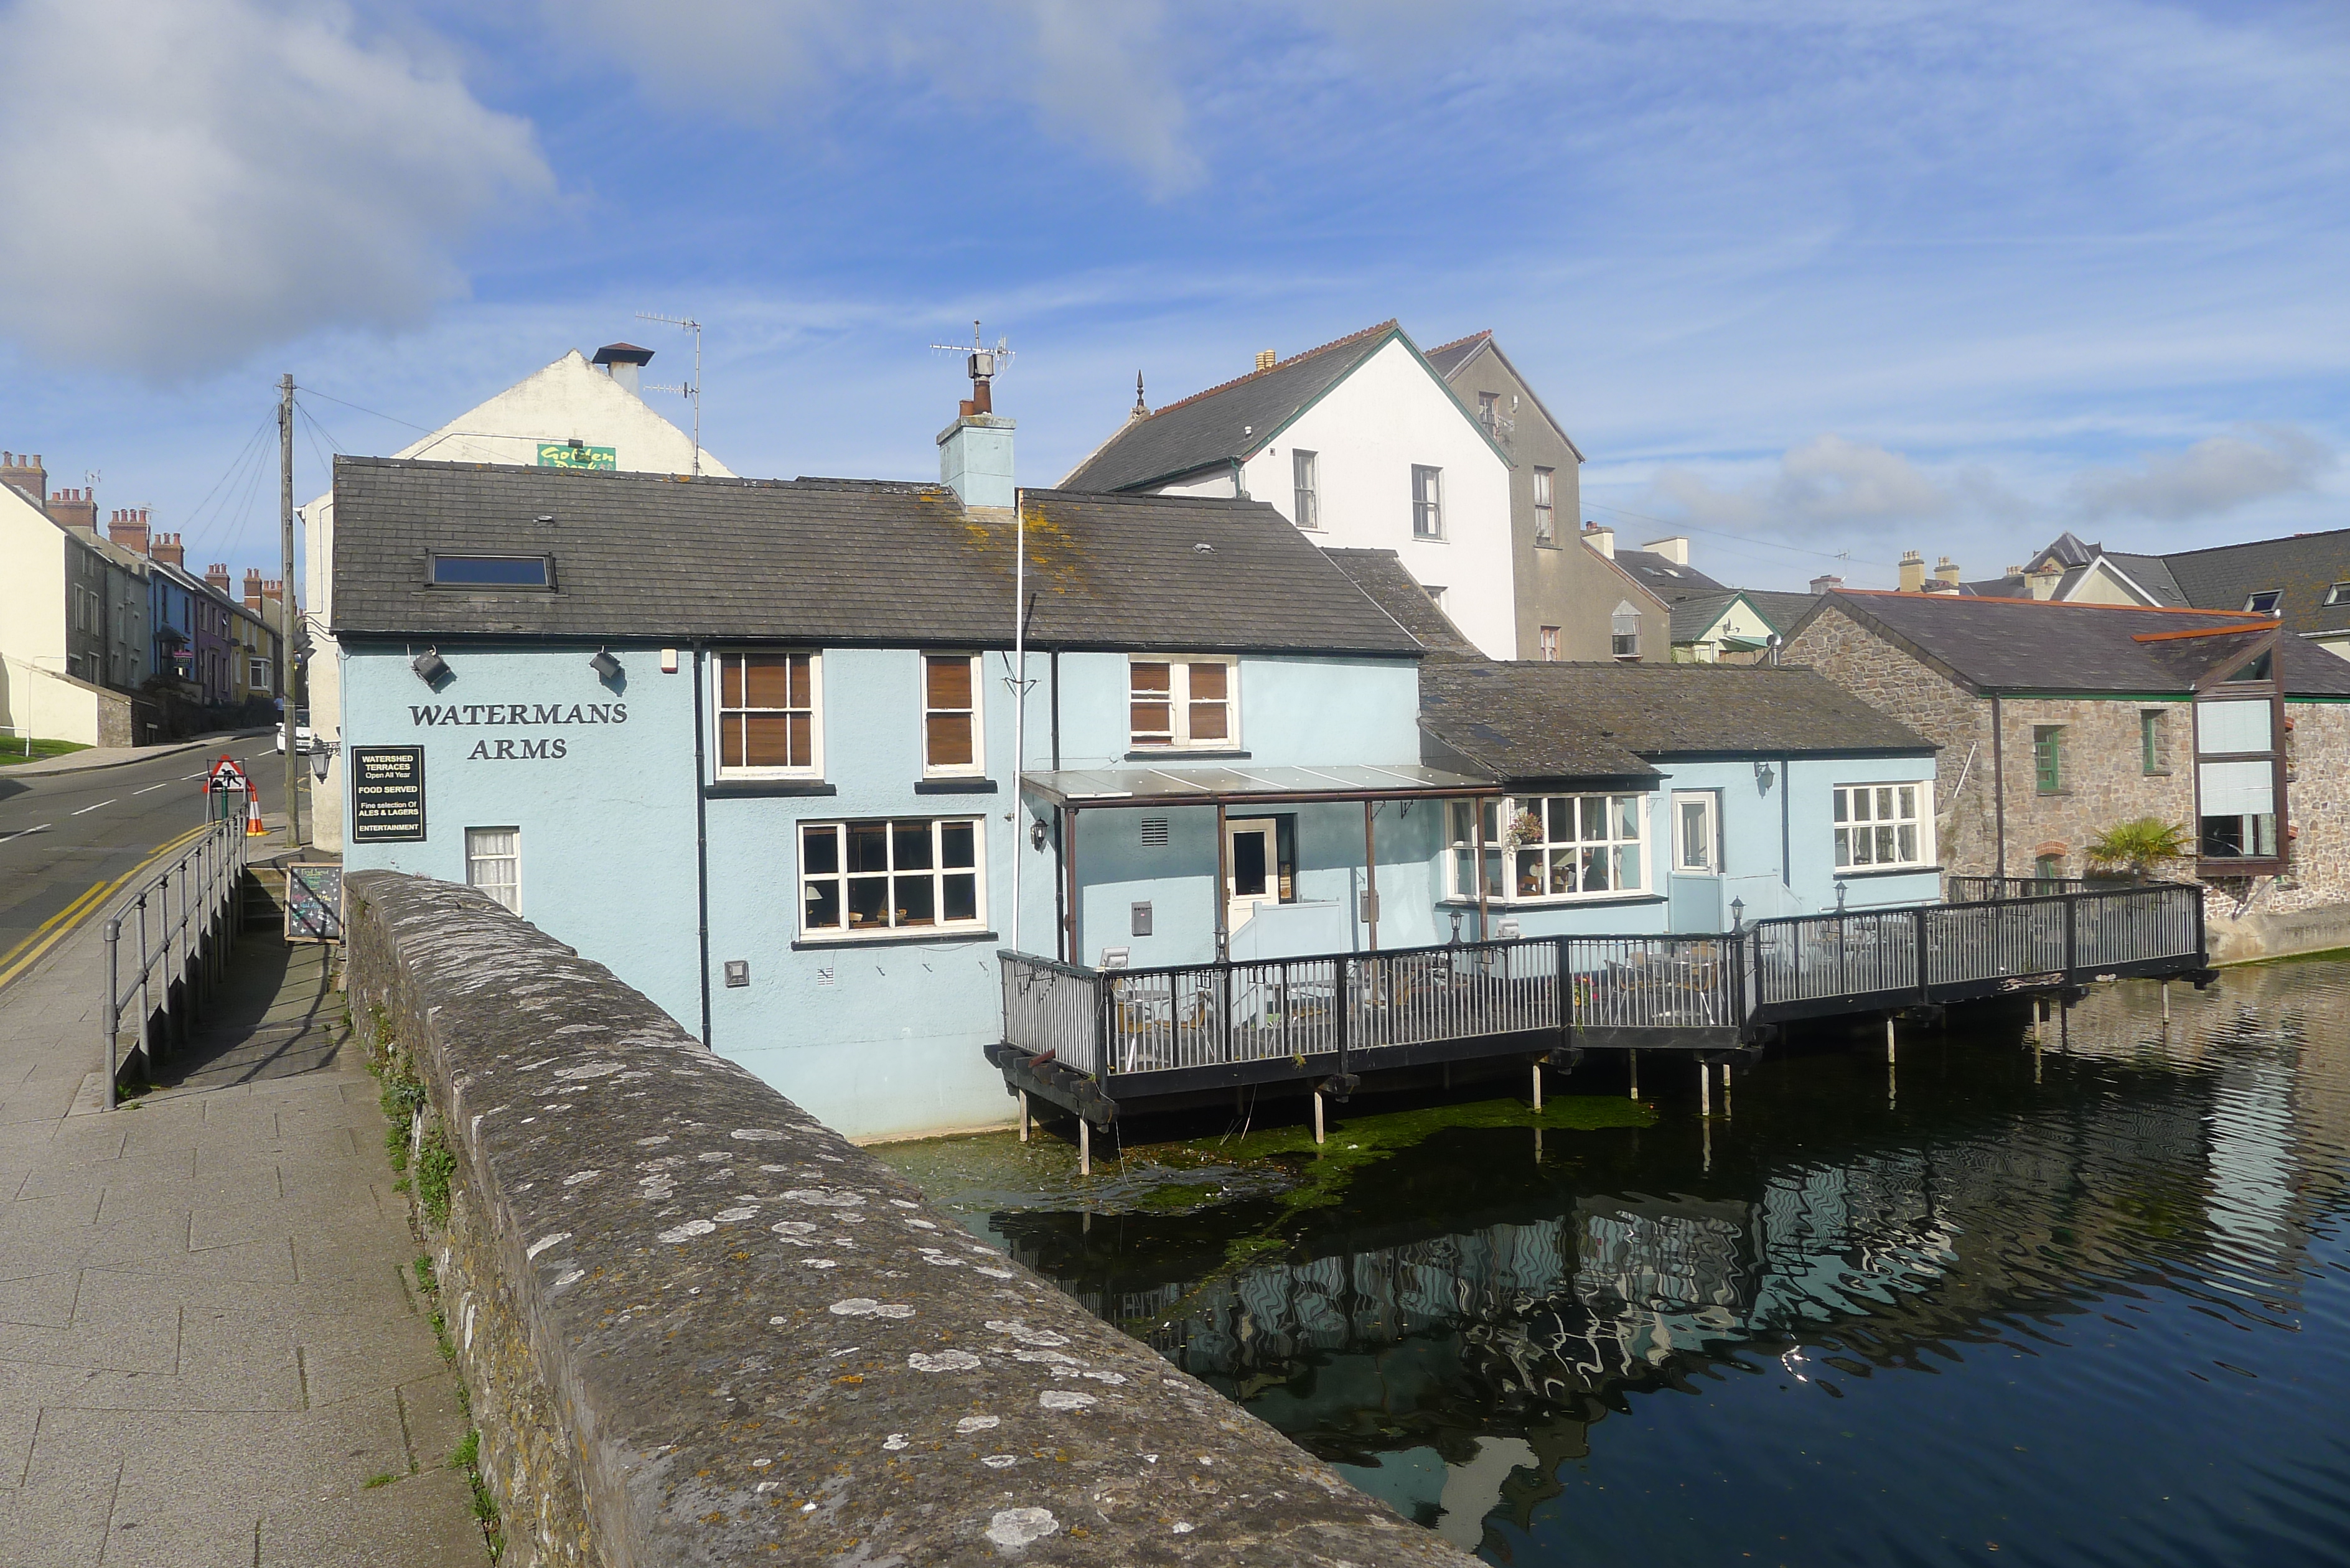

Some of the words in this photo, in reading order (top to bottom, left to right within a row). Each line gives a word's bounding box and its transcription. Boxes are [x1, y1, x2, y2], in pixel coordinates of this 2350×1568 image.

[407, 702, 628, 726] WATERMANS
[362, 755, 414, 763] WATERSHED
[466, 738, 568, 760] ARMS
